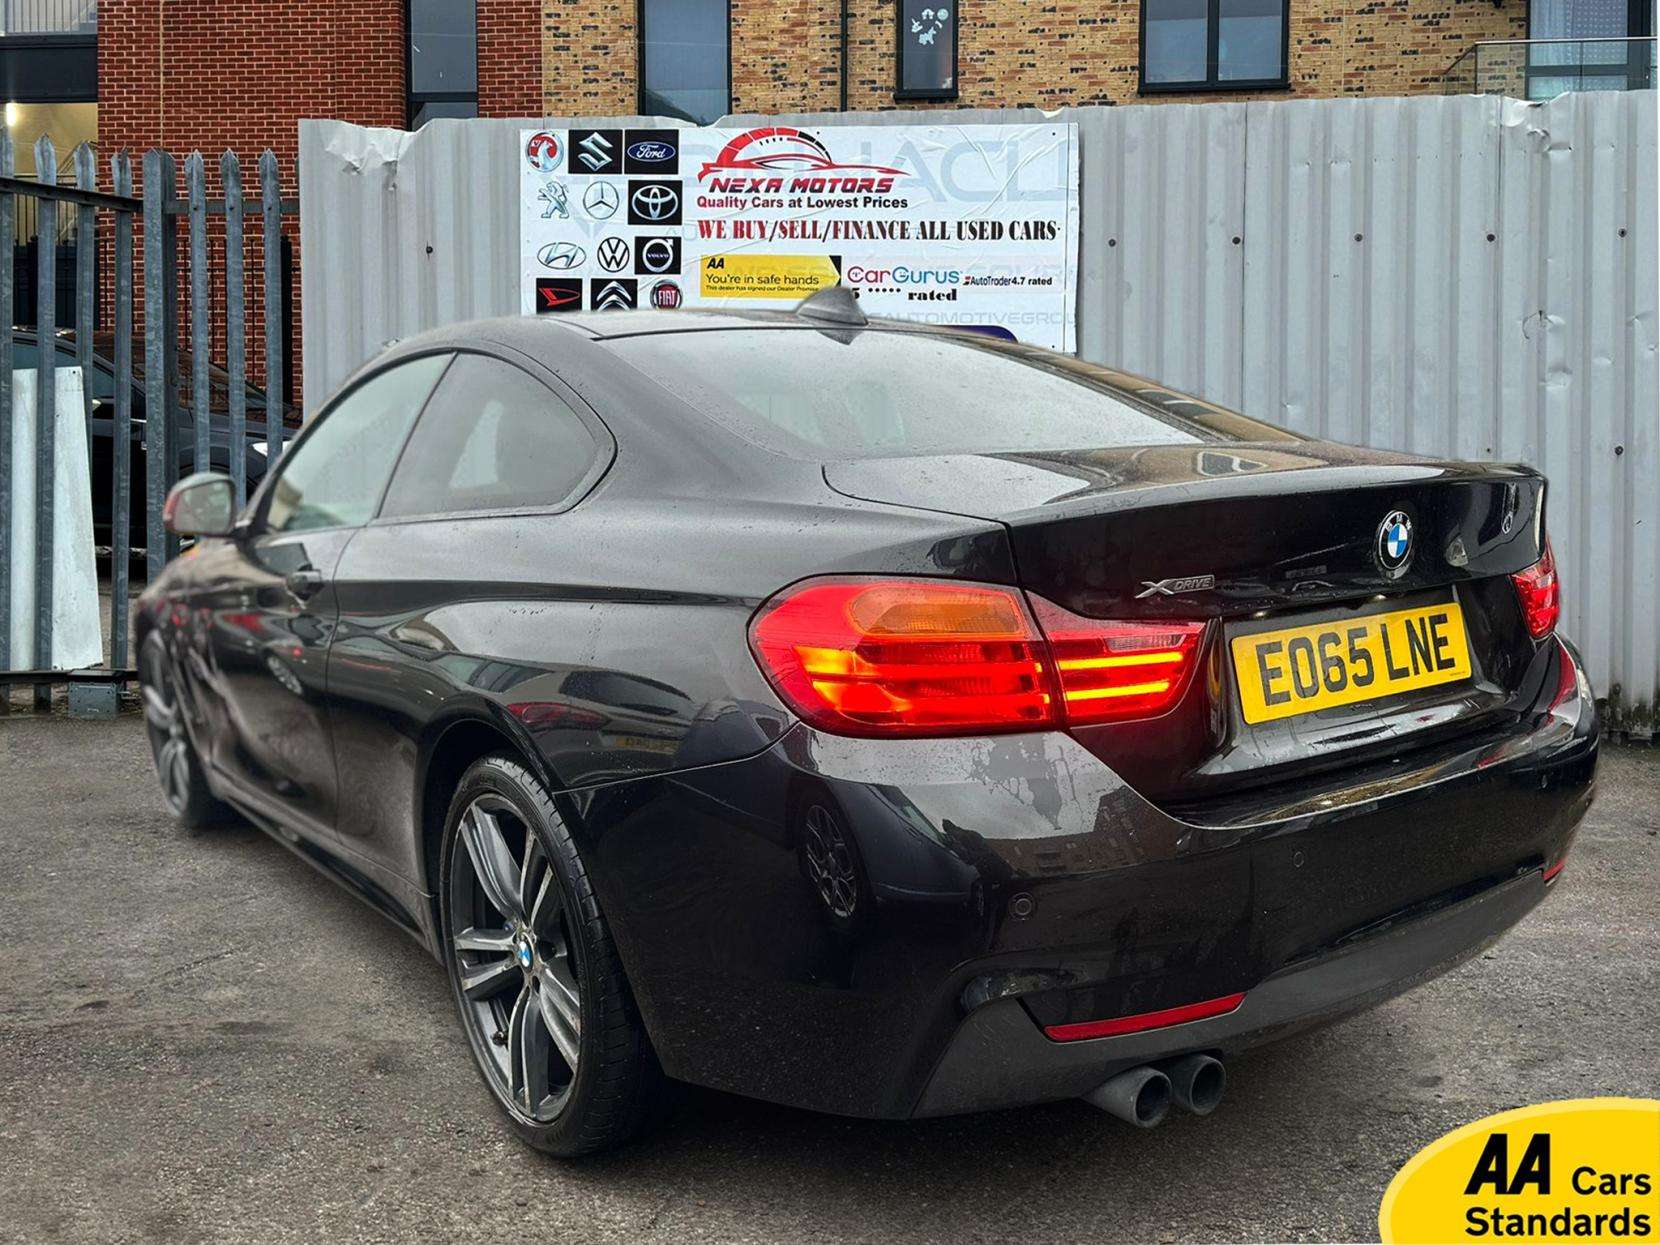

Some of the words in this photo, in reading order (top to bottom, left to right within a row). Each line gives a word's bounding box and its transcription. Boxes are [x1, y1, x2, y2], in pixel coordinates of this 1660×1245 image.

[636, 144, 666, 159] Ford
[708, 177, 785, 194] NEXA
[789, 177, 895, 194] MOTORS
[697, 196, 748, 211] Quality
[751, 196, 784, 208] Cars
[788, 196, 802, 208] at
[807, 196, 859, 208] Lowest
[863, 196, 908, 208] Prices
[697, 219, 727, 240] WE
[916, 220, 951, 240] ALL
[957, 220, 1004, 241] USED
[1009, 220, 1057, 241] CARS
[706, 257, 725, 270] AA
[706, 273, 742, 285] You're
[743, 273, 755, 285] in
[757, 273, 782, 285] safe
[784, 274, 820, 285] hands
[847, 265, 961, 285] CarGurus
[1028, 276, 1053, 285] rated
[658, 289, 676, 305] FIAT
[908, 288, 958, 301] rated
[1380, 613, 1456, 681] LNE
